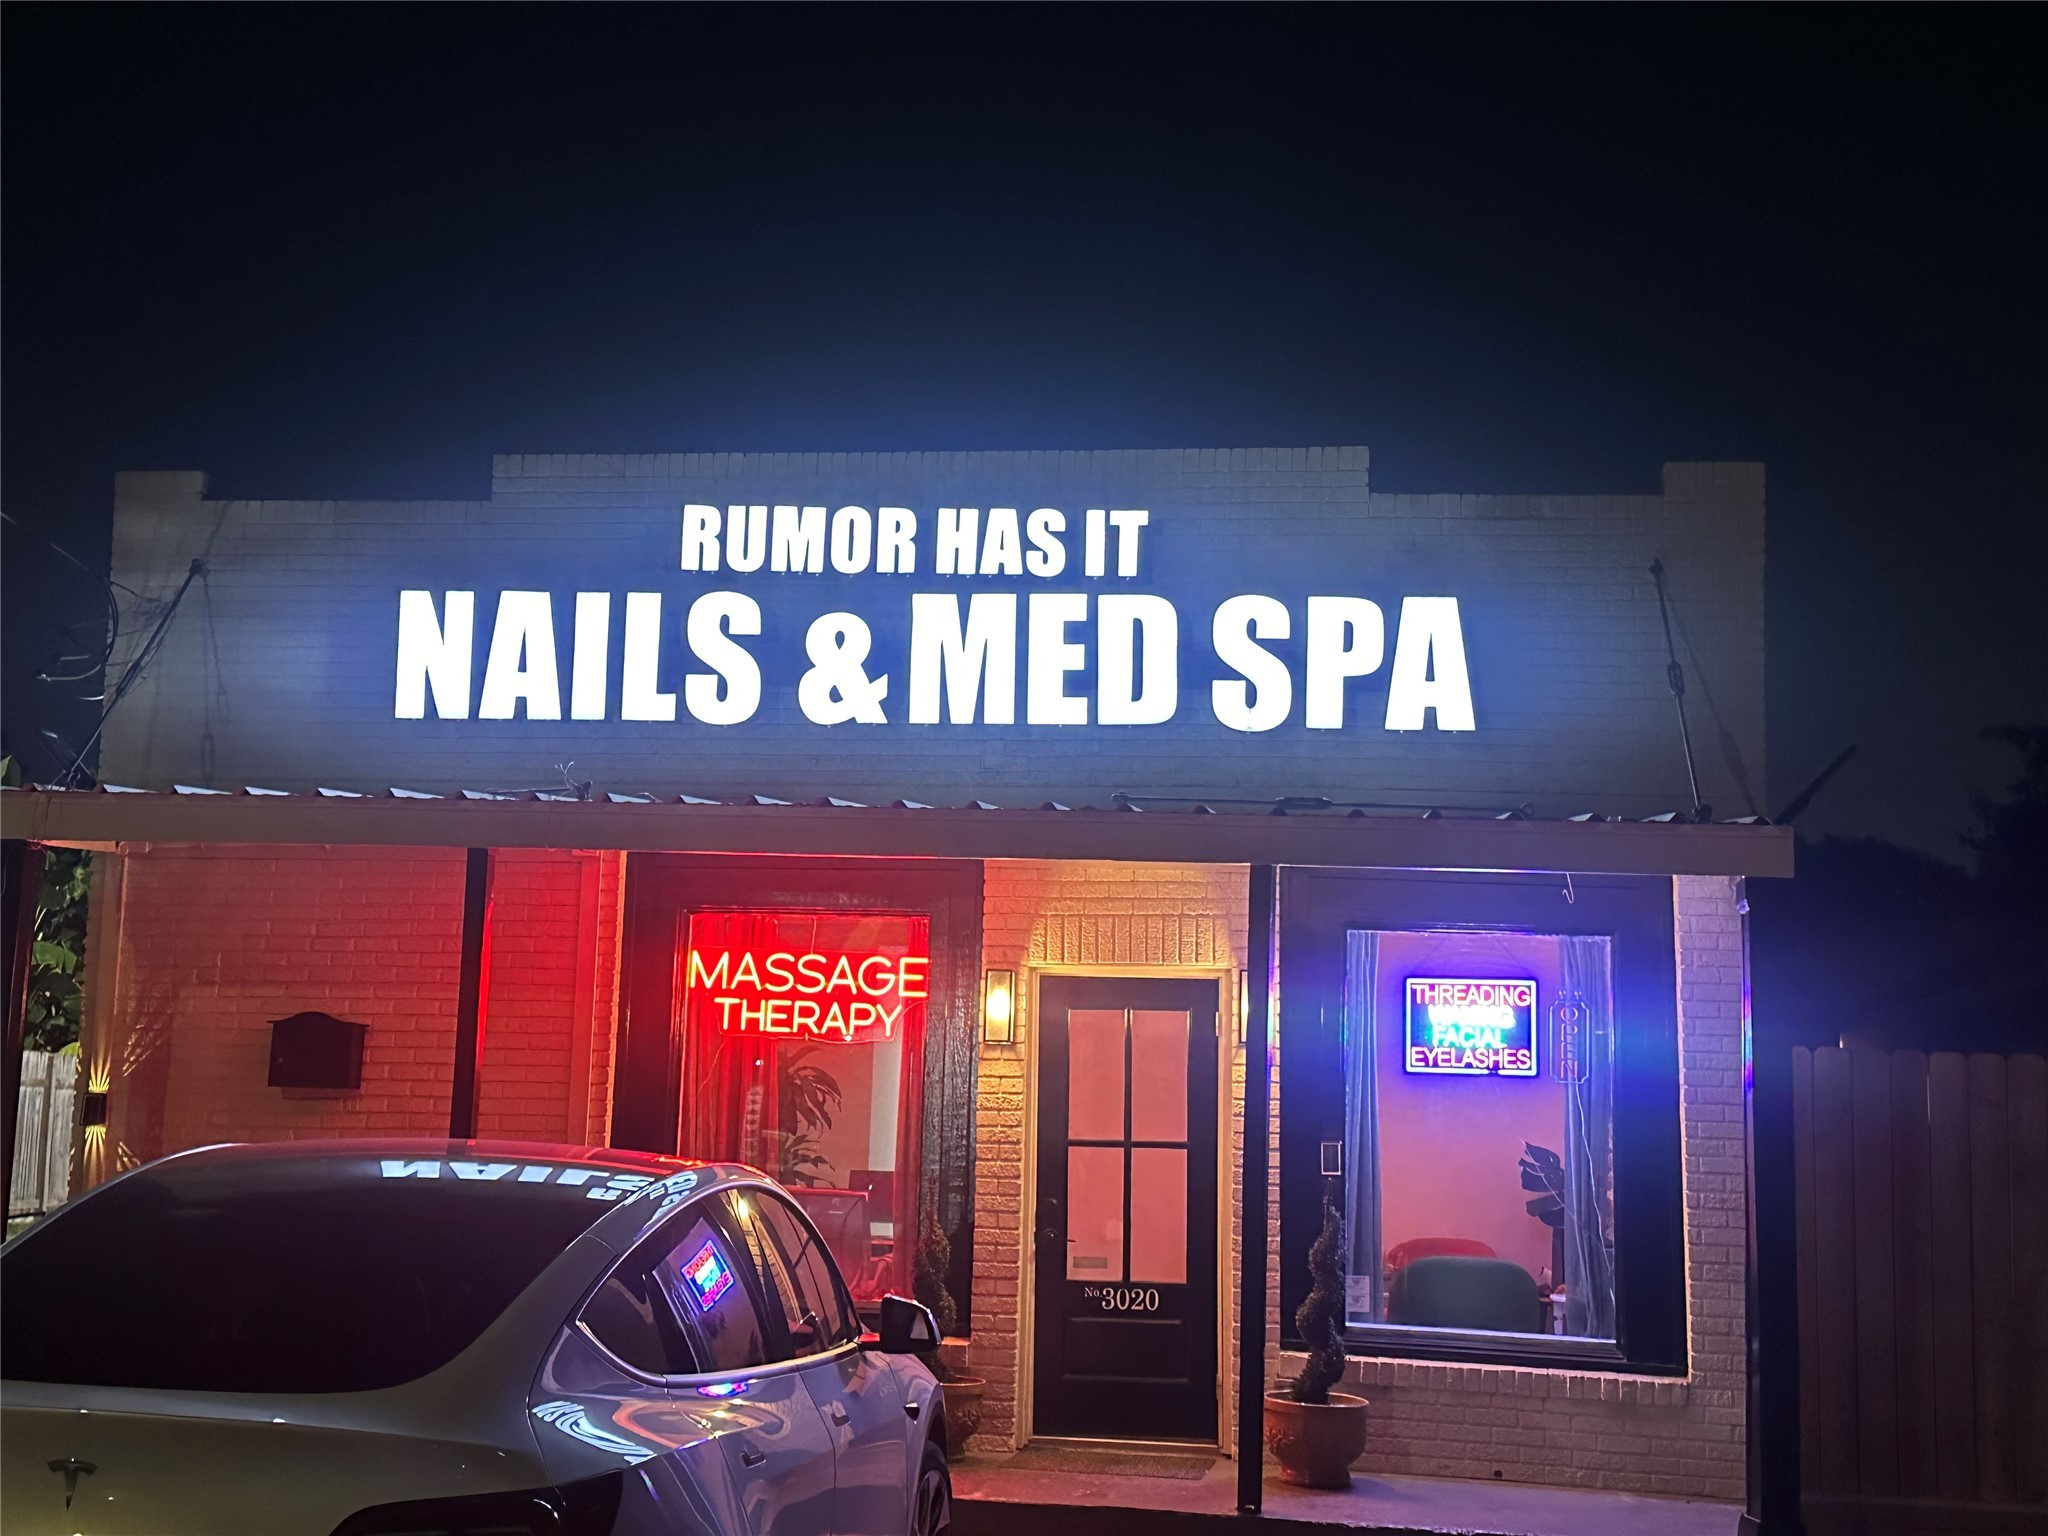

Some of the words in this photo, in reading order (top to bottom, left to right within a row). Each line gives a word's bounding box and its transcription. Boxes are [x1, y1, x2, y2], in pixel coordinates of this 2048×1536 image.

[681, 504, 917, 574] RUMOR
[936, 508, 1066, 577] HAS
[1085, 509, 1149, 577] IT
[395, 590, 761, 725] NAILS
[798, 612, 888, 725] &
[909, 593, 1178, 725] MED
[1212, 594, 1476, 732] SPA
[689, 950, 929, 998] MASSAGE
[1411, 984, 1531, 1006] THREADING
[714, 997, 902, 1037] THERAPY
[1432, 1025, 1508, 1049] FACIAL
[1411, 1046, 1531, 1069] EYELASHES
[1102, 1287, 1159, 1311] 3020
